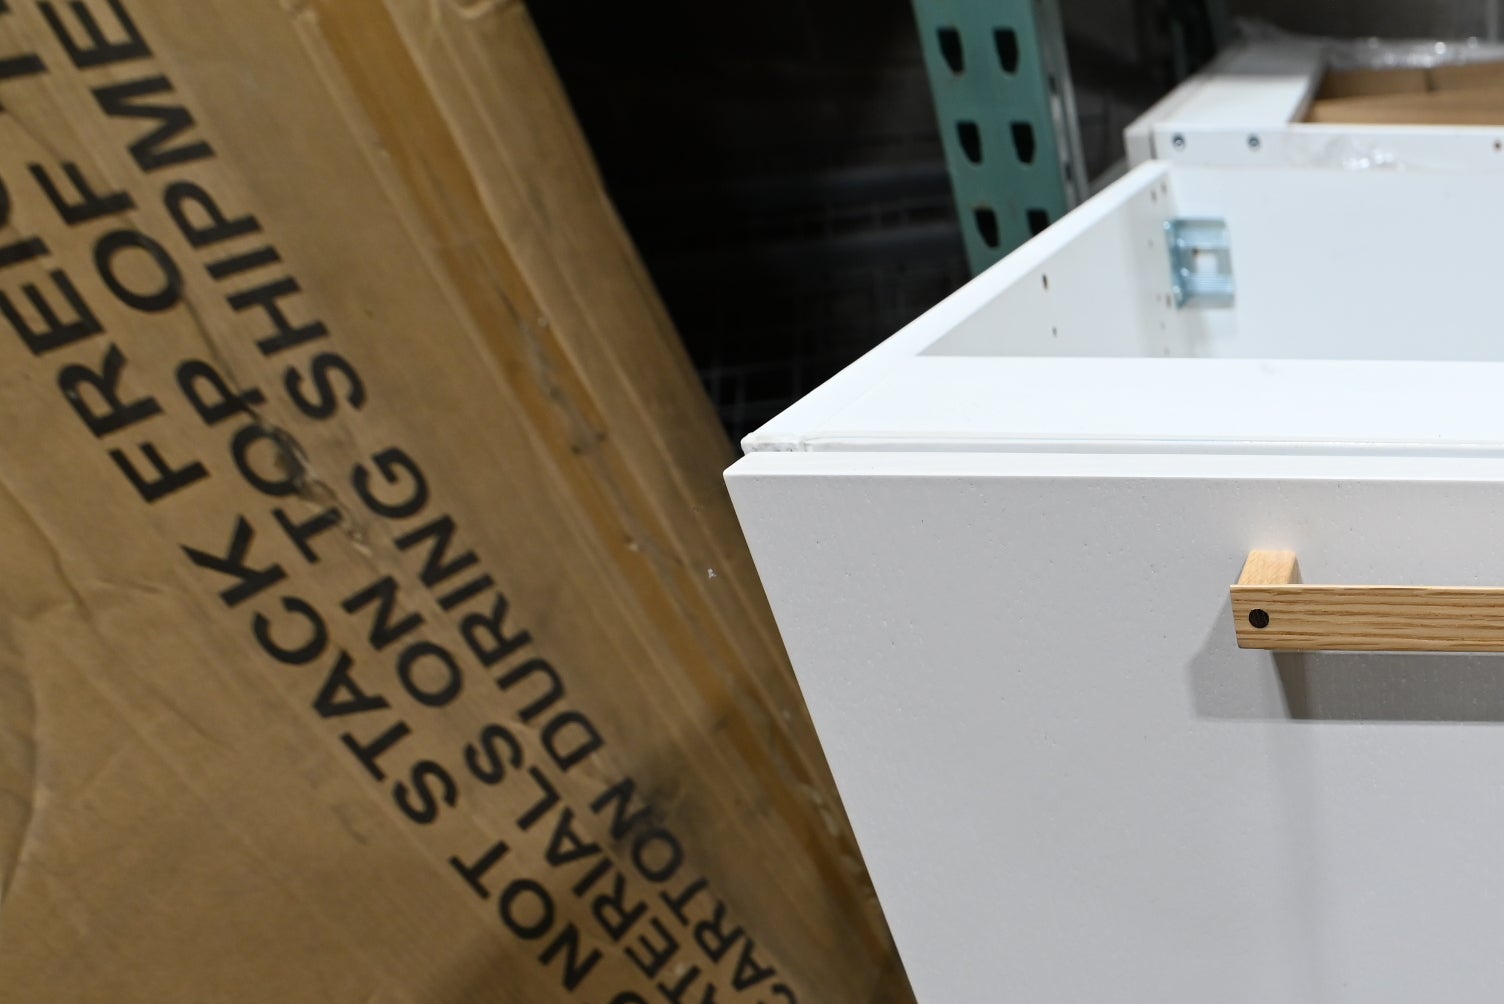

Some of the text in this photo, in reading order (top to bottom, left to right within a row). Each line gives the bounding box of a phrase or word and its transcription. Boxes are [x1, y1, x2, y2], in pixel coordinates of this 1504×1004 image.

[27, 161, 184, 314] OF
[38, 0, 366, 421] SHIPME
[0, 177, 209, 504] FREI
[175, 359, 342, 564] TOP
[181, 515, 458, 825] STACK
[341, 575, 463, 708] ON
[351, 447, 604, 772] DURING
[449, 841, 603, 993] NOT
